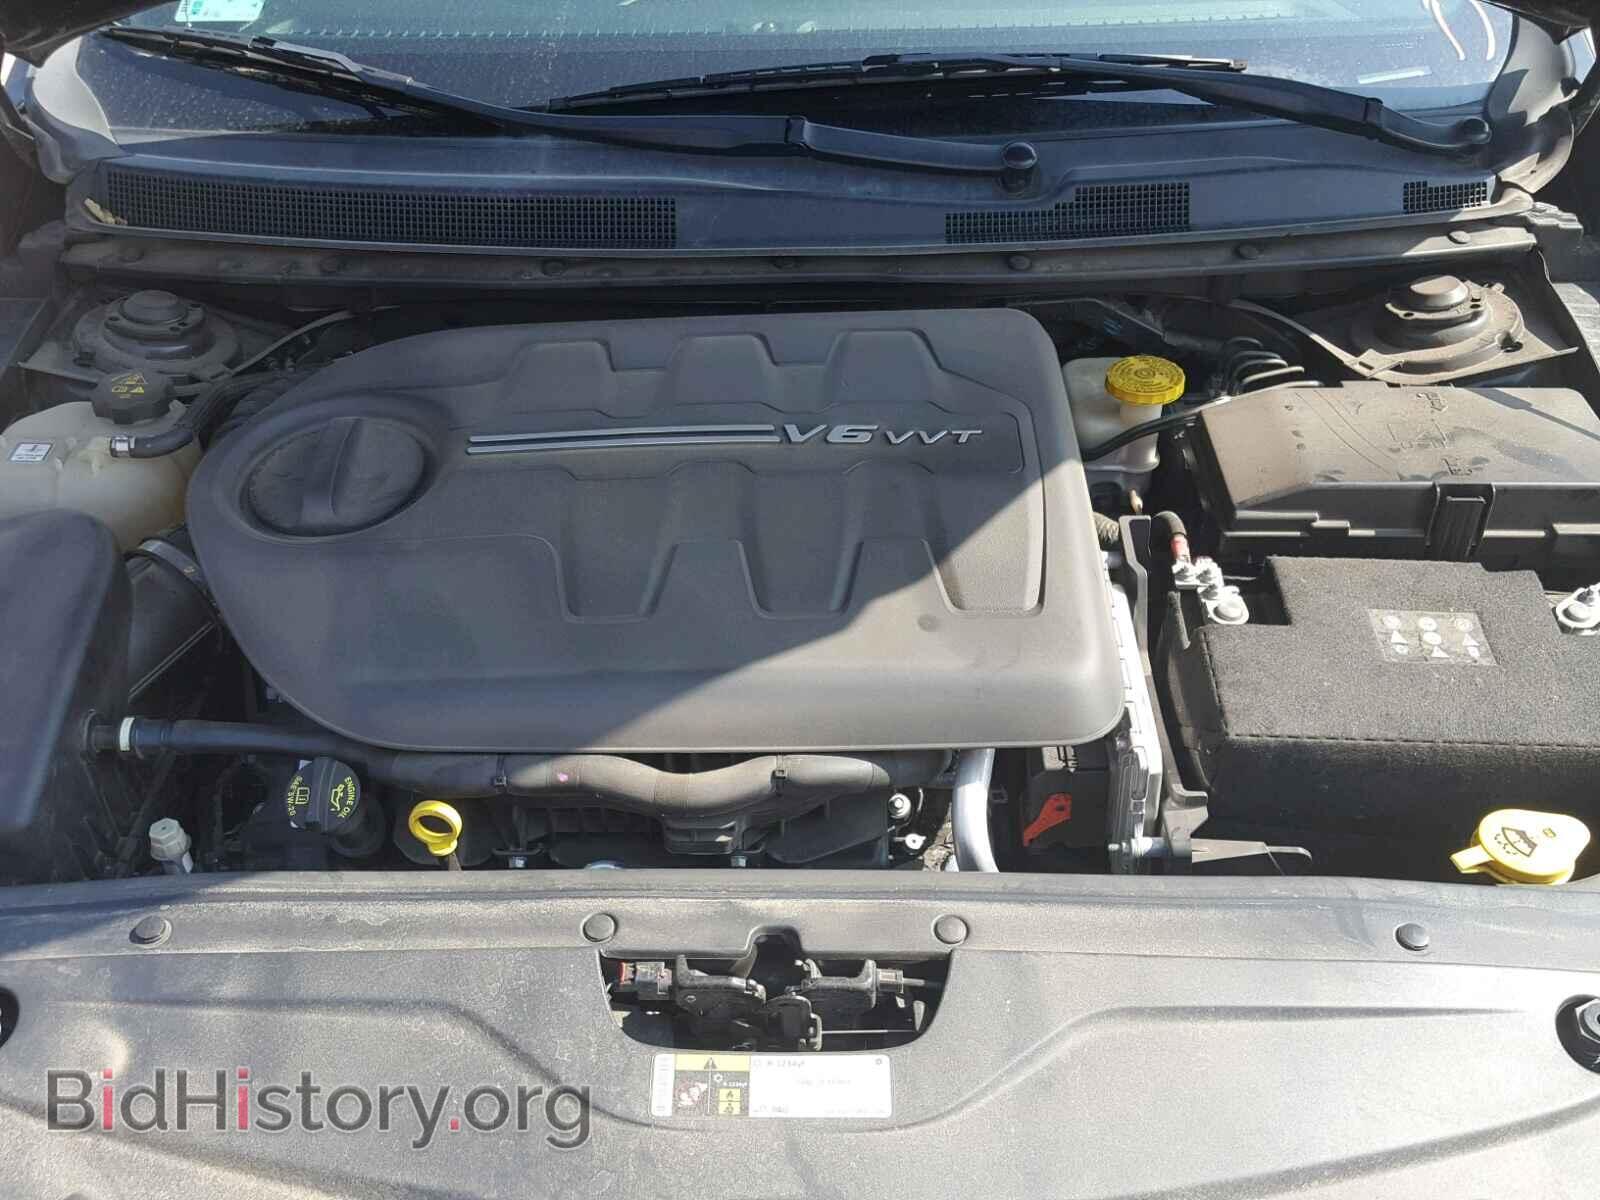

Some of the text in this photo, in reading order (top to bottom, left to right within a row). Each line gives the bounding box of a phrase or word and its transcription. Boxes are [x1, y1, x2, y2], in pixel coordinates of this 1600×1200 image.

[783, 424, 983, 444] V6 VVT
[337, 776, 356, 818] ENGINE OIL
